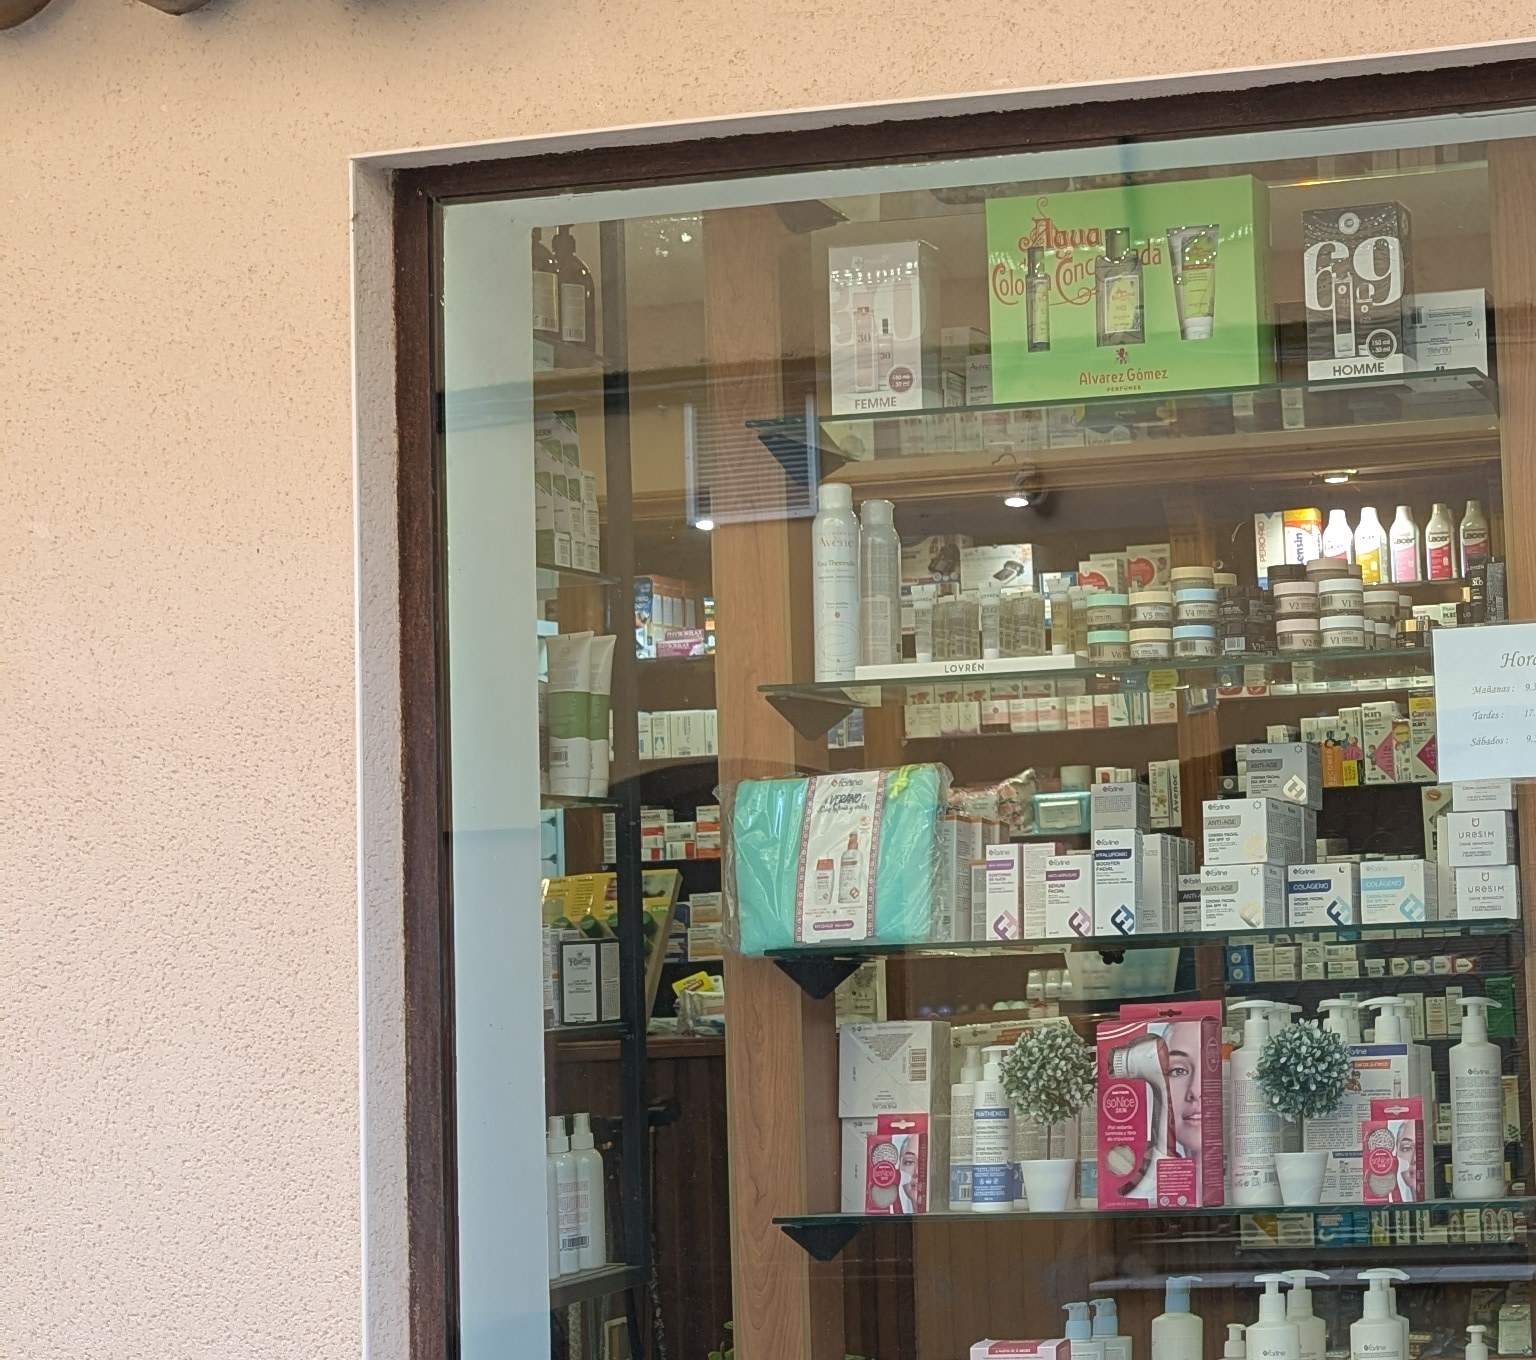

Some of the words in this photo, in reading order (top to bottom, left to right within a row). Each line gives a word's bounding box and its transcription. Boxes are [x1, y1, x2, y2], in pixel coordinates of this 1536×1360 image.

[1333, 362, 1385, 376] HOMME
[1079, 369, 1124, 386] Alvarez
[1127, 368, 1169, 382] Gómez
[855, 396, 897, 410] FEMME
[1463, 531, 1489, 540] Lacer
[944, 663, 985, 674] LOVRÉN
[1472, 710, 1504, 721] Tardes:
[1470, 737, 1509, 747] Sábados:
[1207, 818, 1237, 826] ANTI-AGE
[1205, 884, 1233, 892] ANTI-AGE
[1293, 882, 1329, 891] COLÁGENO
